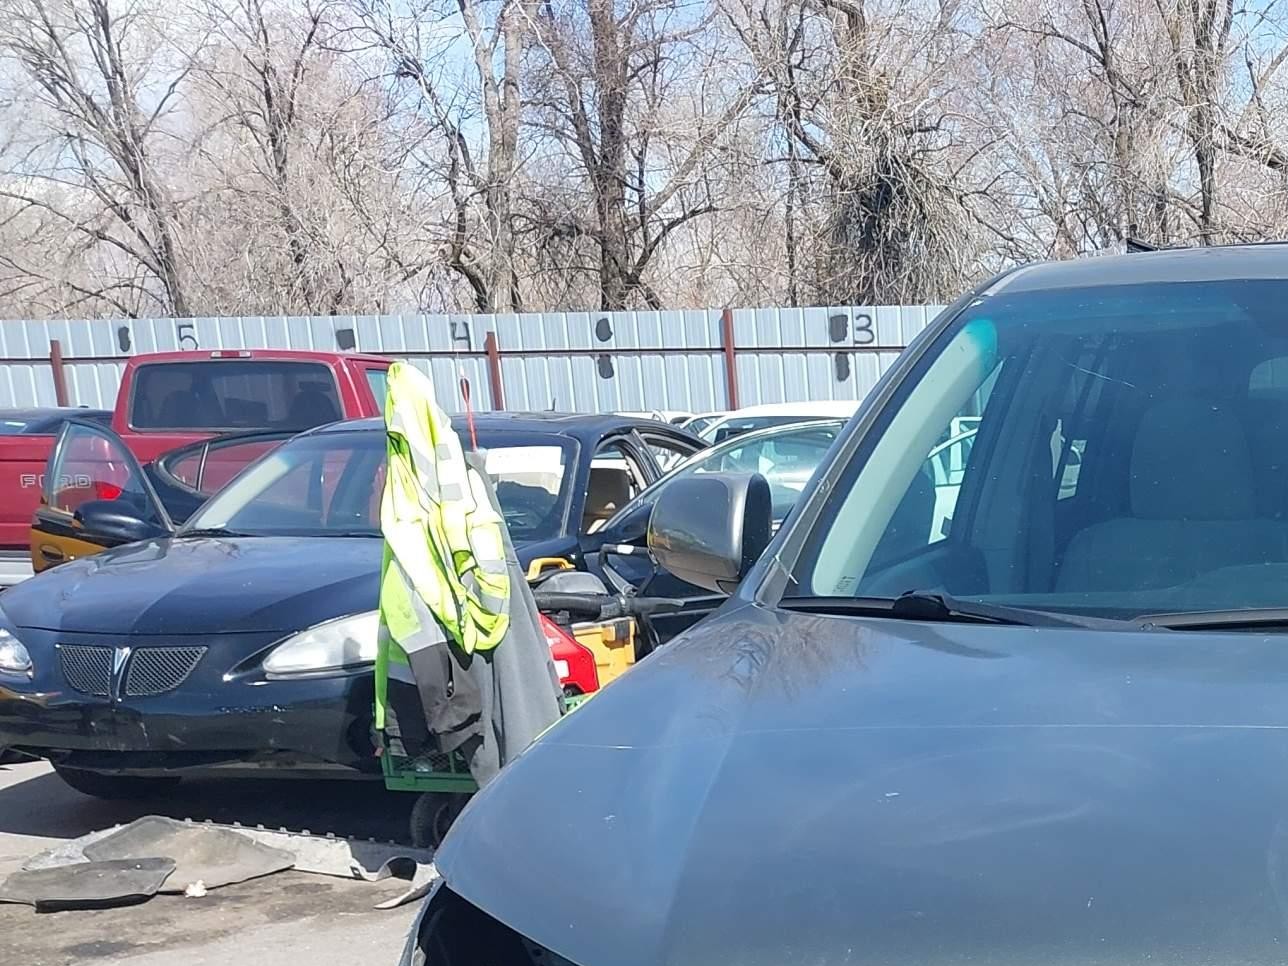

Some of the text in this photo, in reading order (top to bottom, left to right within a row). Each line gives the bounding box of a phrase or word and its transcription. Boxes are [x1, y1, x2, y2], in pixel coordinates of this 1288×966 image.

[177, 324, 199, 351] 5
[450, 321, 472, 352] 4
[854, 314, 875, 344] 3
